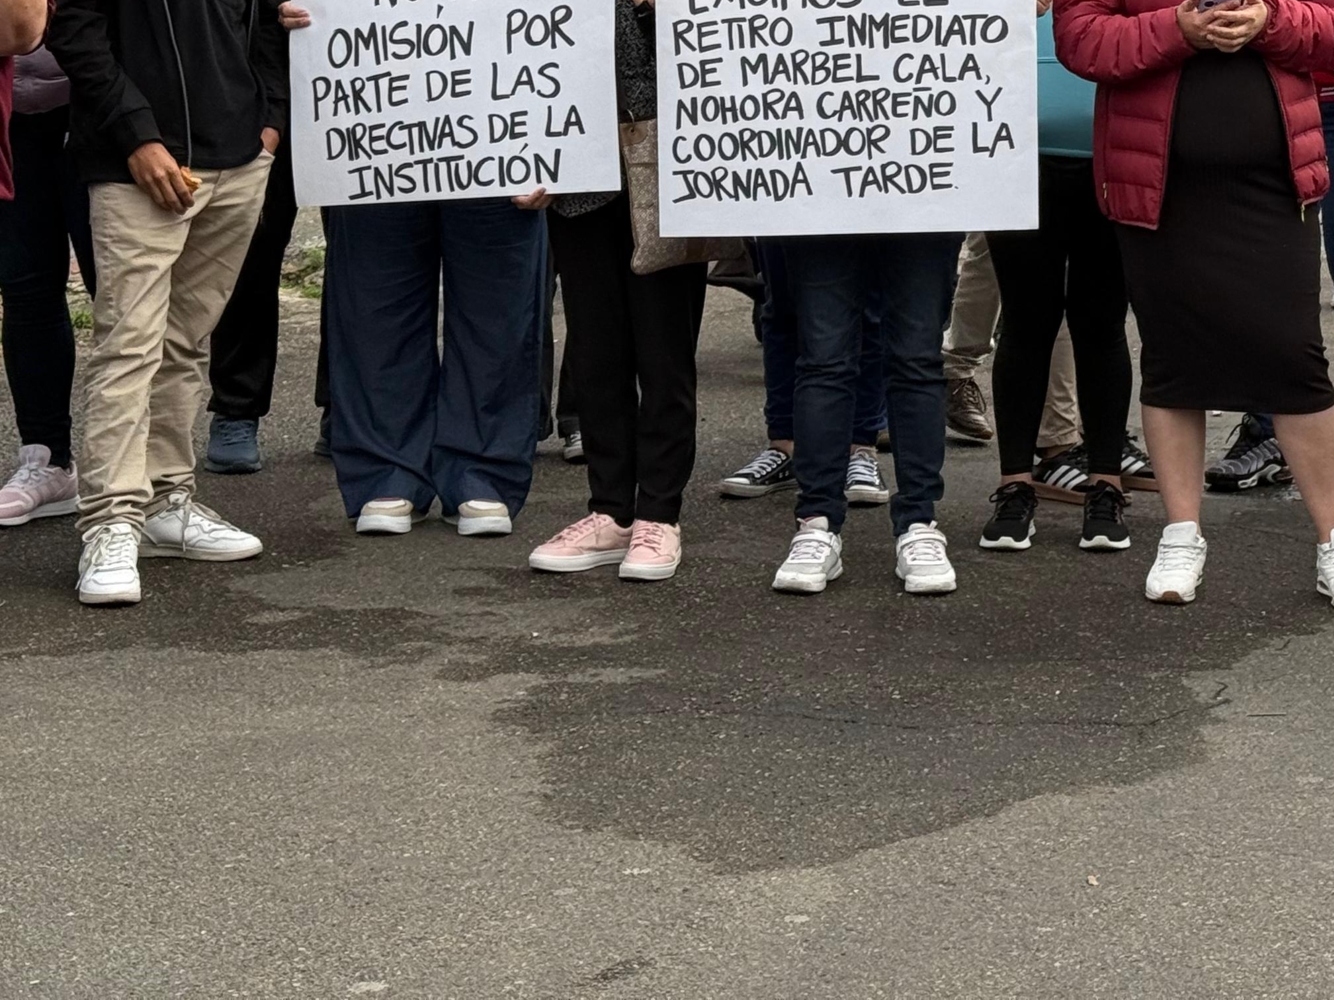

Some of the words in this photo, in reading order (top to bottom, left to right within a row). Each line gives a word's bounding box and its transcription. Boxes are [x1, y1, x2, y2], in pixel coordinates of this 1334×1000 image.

[327, 4, 474, 69] OMISIÓN
[506, 4, 575, 54] POR
[672, 14, 793, 56] RETIRO
[816, 12, 1009, 49] INMEDIATO
[677, 57, 723, 89] DE
[740, 49, 880, 87] MARBEL
[893, 53, 991, 85] CALA,
[312, 71, 410, 122] PARTE
[425, 69, 472, 102] DE
[491, 61, 561, 101] LAS
[676, 88, 804, 130] NOHORA
[816, 86, 956, 123] CARREÑO
[975, 86, 1003, 122] Y
[326, 114, 478, 161] DIRECTIVAS
[488, 110, 528, 143] DE
[545, 104, 585, 137] LA
[672, 123, 891, 165] COORDINADOR
[910, 126, 955, 155] DE
[972, 122, 1015, 158] LA
[347, 143, 561, 201] INSTITUCIÓN
[672, 161, 813, 203] JORNADA
[830, 161, 959, 198] TARDE.
